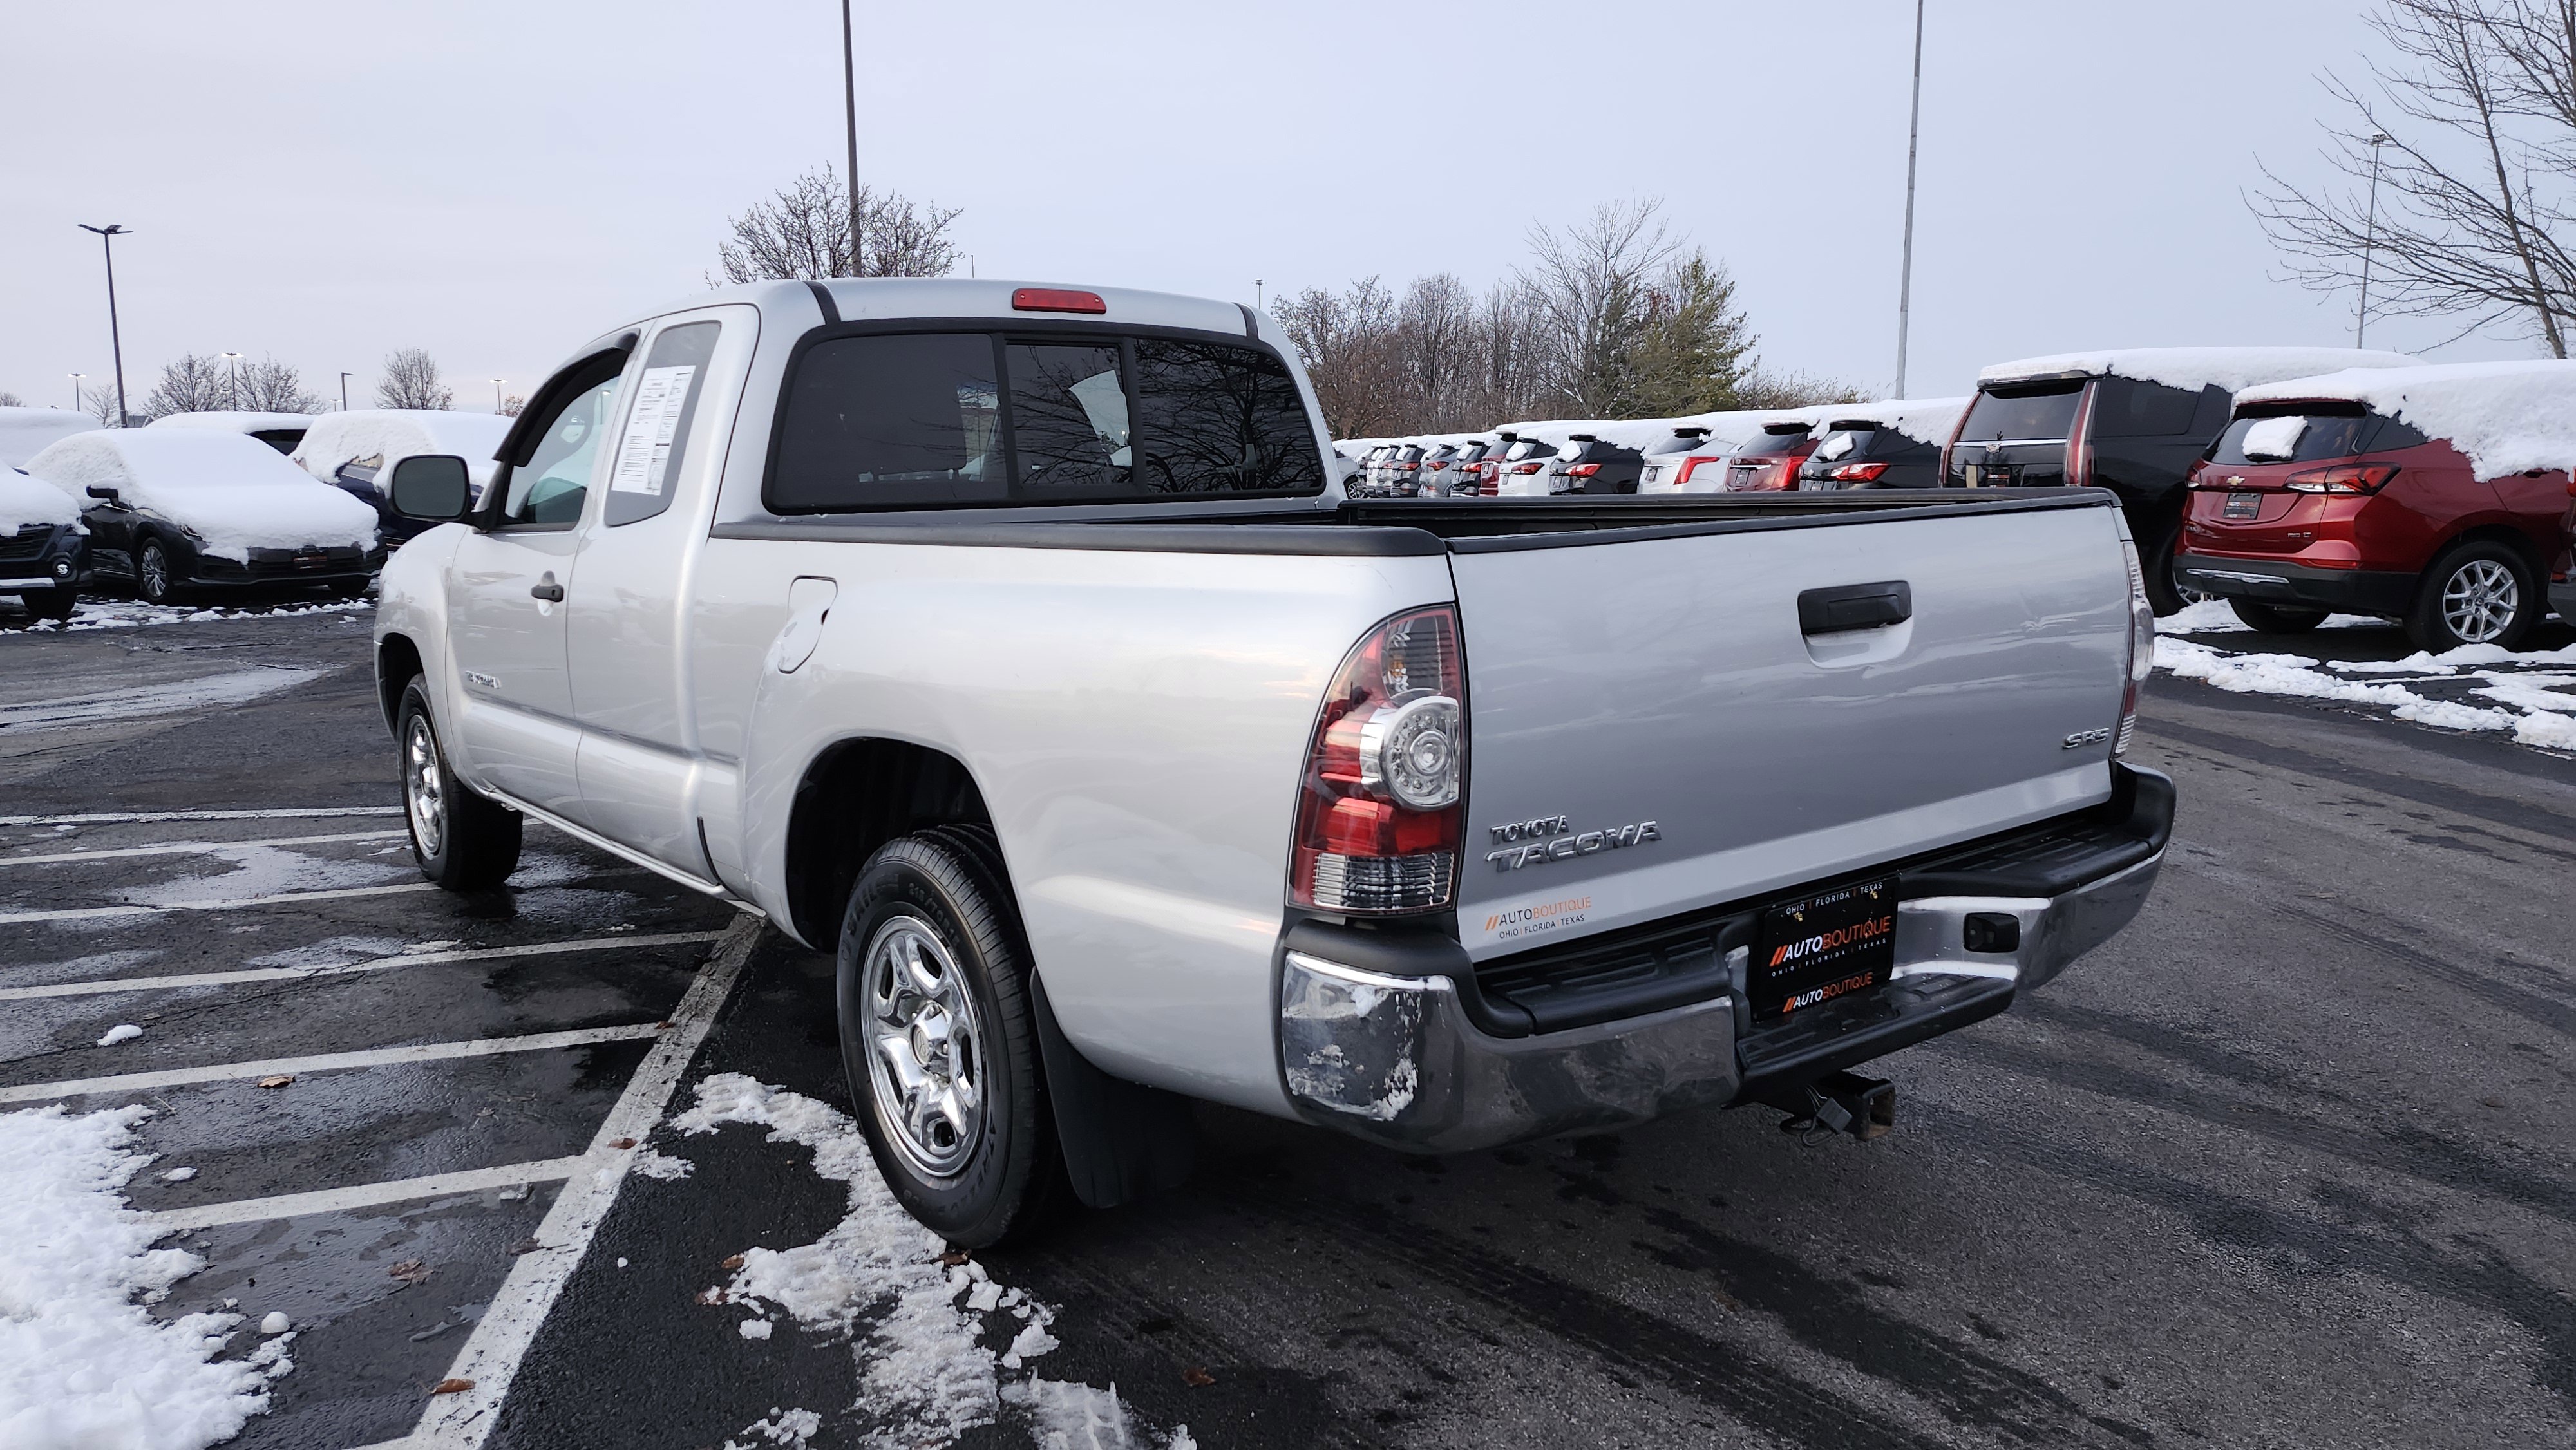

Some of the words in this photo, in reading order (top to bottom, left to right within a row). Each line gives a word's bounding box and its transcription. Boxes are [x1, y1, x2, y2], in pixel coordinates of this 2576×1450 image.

[1484, 820, 1662, 872] TACOMA
[1489, 815, 1569, 845] TOYOTA
[1499, 896, 1592, 926] AUTOBOUTIQUE
[1786, 905, 1805, 915] OHIO
[1815, 891, 1850, 907] FLORIDA
[1860, 882, 1883, 895] TEXAS
[1499, 927, 1519, 939] OHIO
[1524, 921, 1556, 934] FLORIDA
[1561, 914, 1584, 926] TEXAS
[1783, 916, 1891, 962] AUTOBOUTIQUE
[1772, 965, 1794, 977] OHIO
[1806, 950, 1846, 966] FLORIDA
[1859, 938, 1886, 950] TEXAS
[1792, 972, 1873, 1009] AUTOBOUTIQUE
